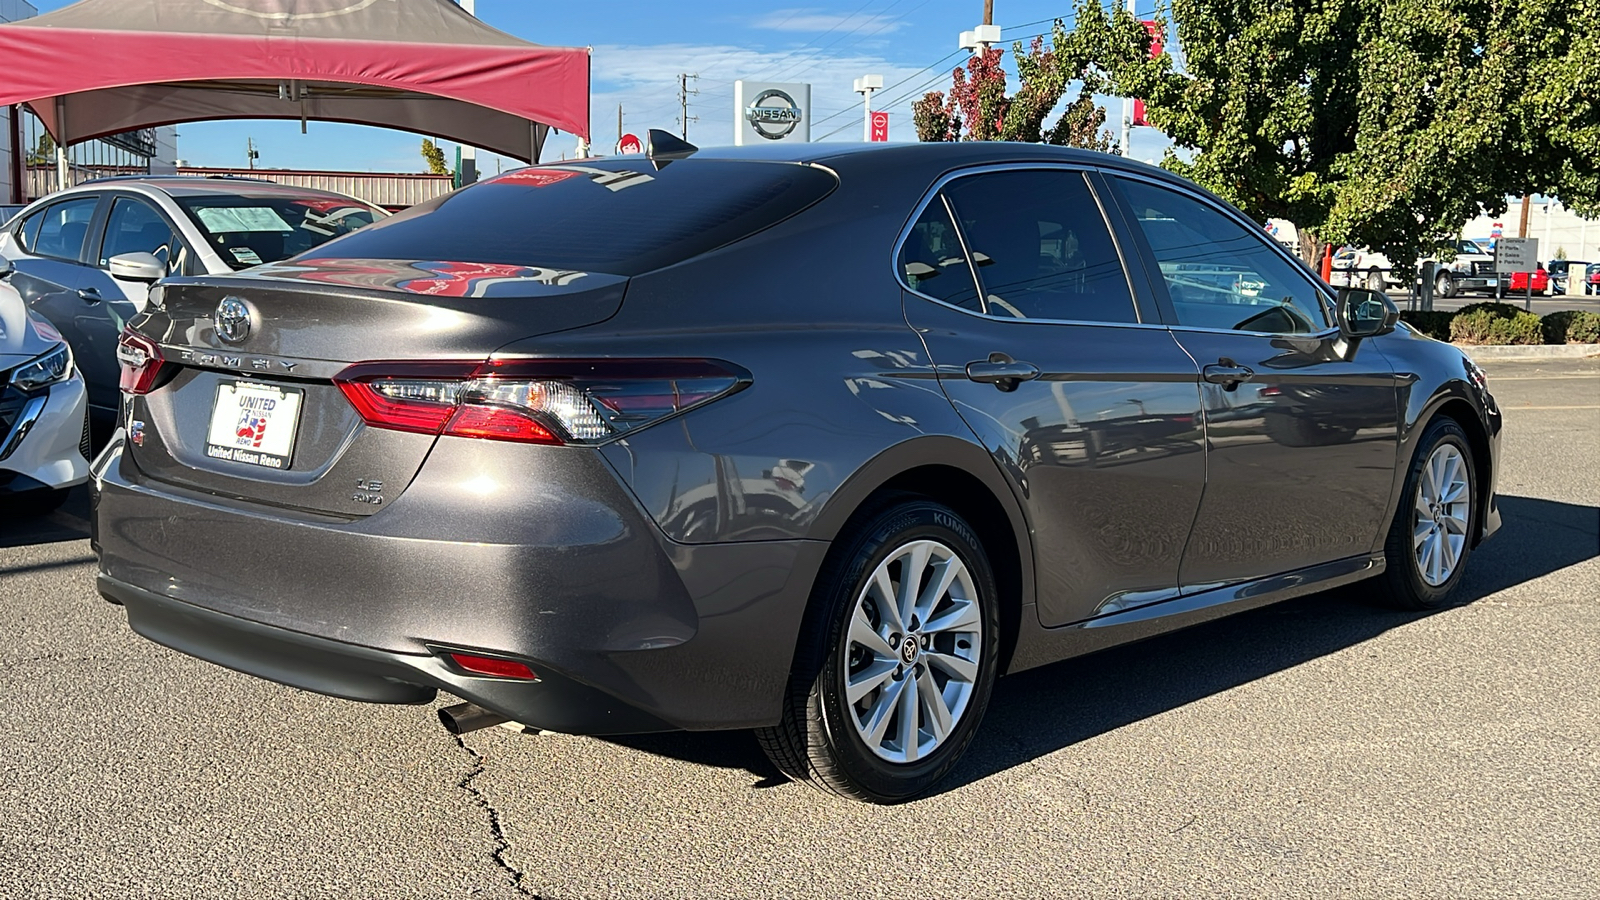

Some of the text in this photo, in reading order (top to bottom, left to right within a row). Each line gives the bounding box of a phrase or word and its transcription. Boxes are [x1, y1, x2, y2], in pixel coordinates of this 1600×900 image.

[751, 109, 797, 120] NISSAN
[181, 351, 299, 372] CAMRY
[239, 395, 277, 411] UNITED
[252, 410, 272, 419] NISSAN
[236, 437, 252, 447] RENO
[208, 446, 282, 468] United Nissan Reno
[356, 478, 383, 492] LE
[352, 492, 384, 505] AWD
[933, 512, 978, 550] KUMHO
